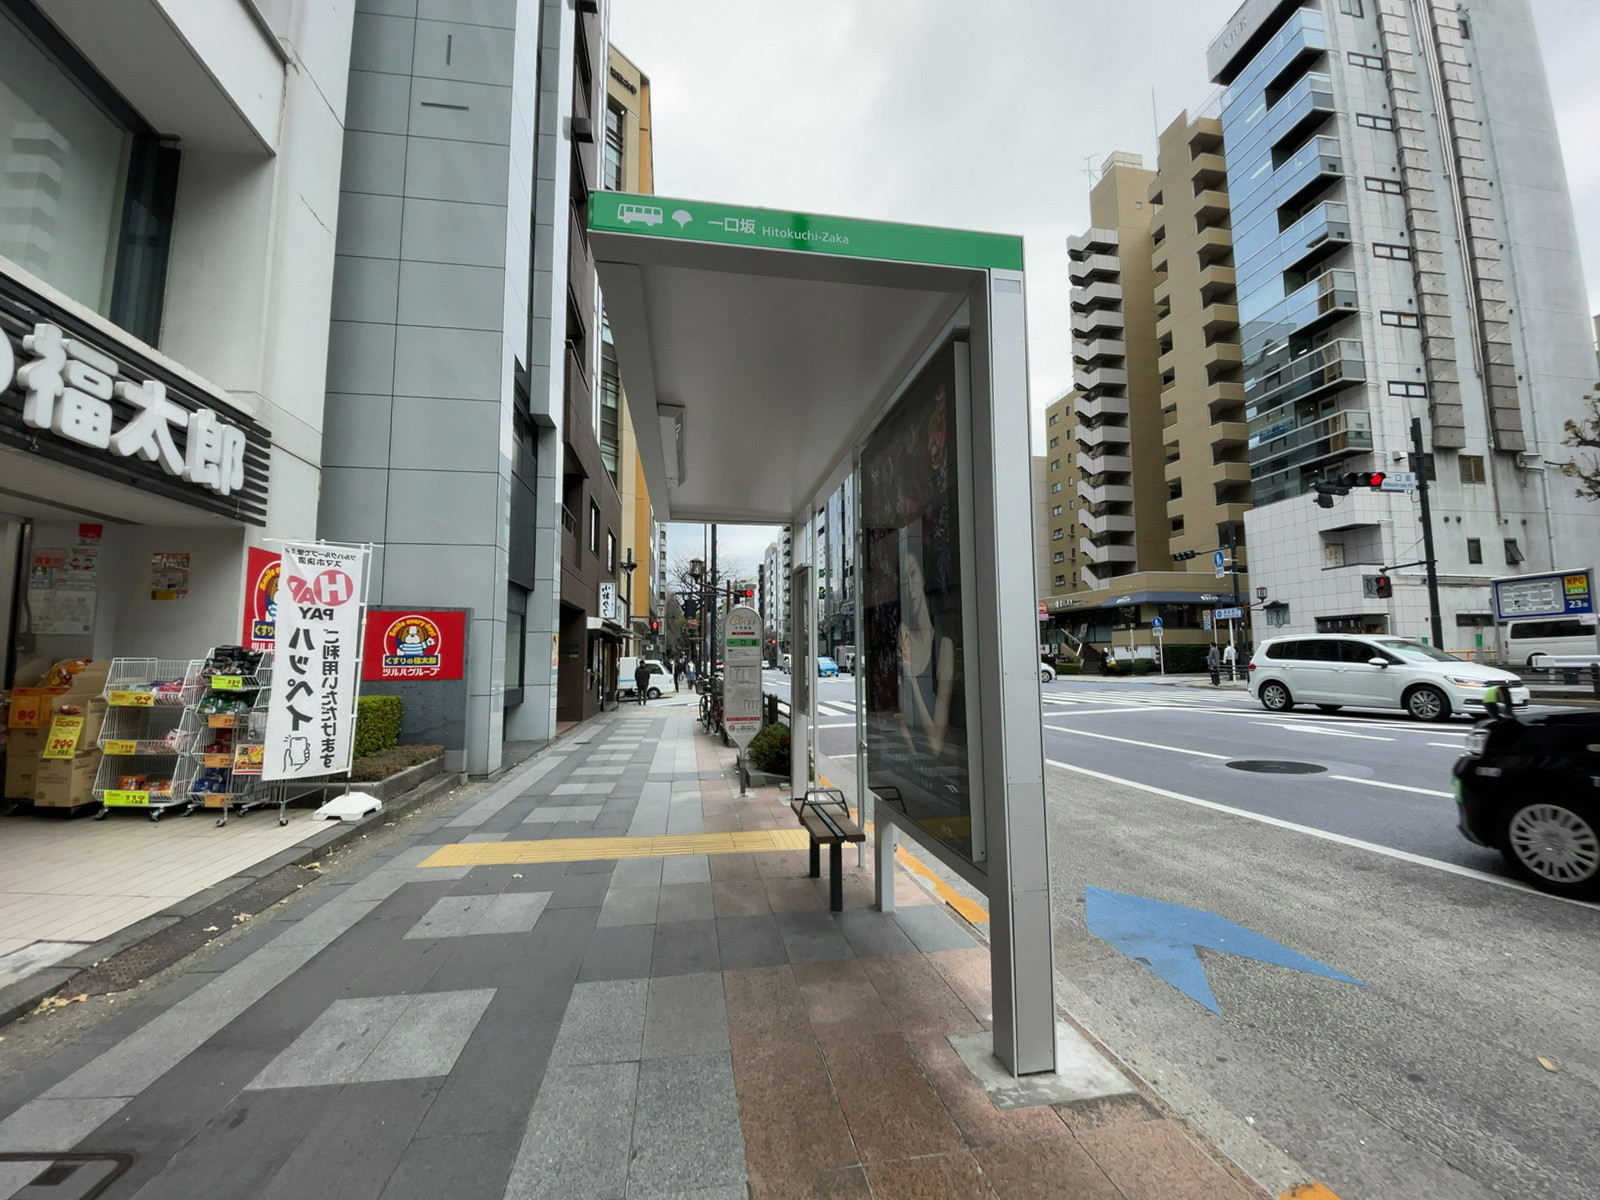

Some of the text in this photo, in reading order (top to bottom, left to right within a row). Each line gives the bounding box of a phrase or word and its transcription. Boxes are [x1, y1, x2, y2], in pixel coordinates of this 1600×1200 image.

[708, 217, 850, 245] 一口坂 Hitokuchi-Zaka
[0, 323, 246, 496] 福太郎
[259, 570, 275, 591] Smile
[254, 624, 275, 637] くすり
[389, 621, 406, 638] Smile
[406, 618, 426, 628] every
[385, 657, 437, 665] くすりの福太郎
[382, 667, 440, 677] ツルハグループ
[52, 739, 74, 749] 299
